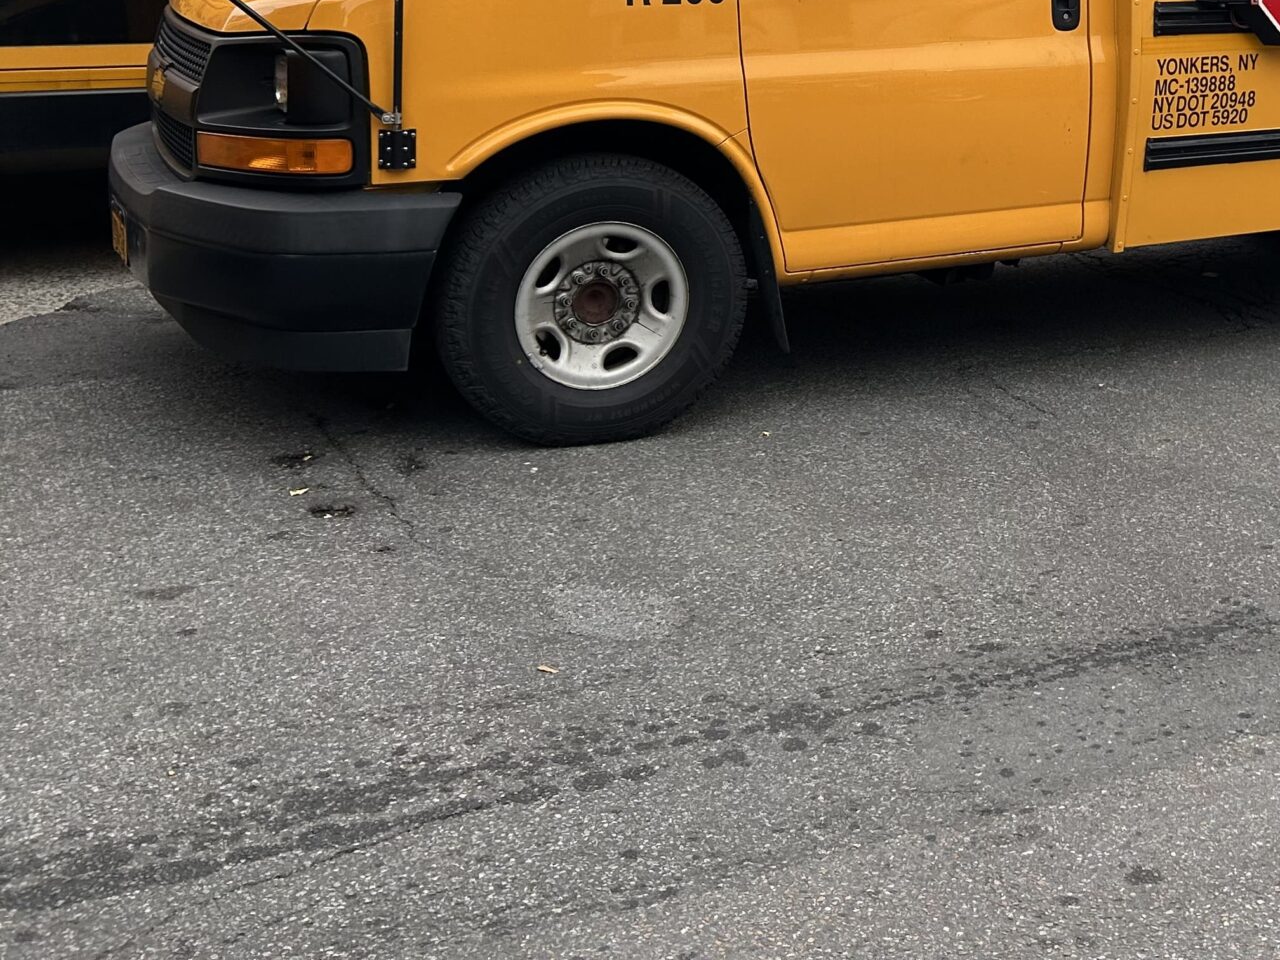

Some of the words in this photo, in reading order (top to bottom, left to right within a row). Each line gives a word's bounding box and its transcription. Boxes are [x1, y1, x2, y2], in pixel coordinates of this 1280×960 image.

[1157, 54, 1233, 76] YONKERS,
[1238, 53, 1259, 71] NY
[1154, 75, 1236, 97] MC-139888
[1153, 96, 1175, 114] NY
[1176, 94, 1209, 113] DOT
[1211, 91, 1256, 110] 20948
[1151, 113, 1174, 131] US
[1176, 110, 1209, 129] DOT
[1211, 108, 1248, 126] 5920
